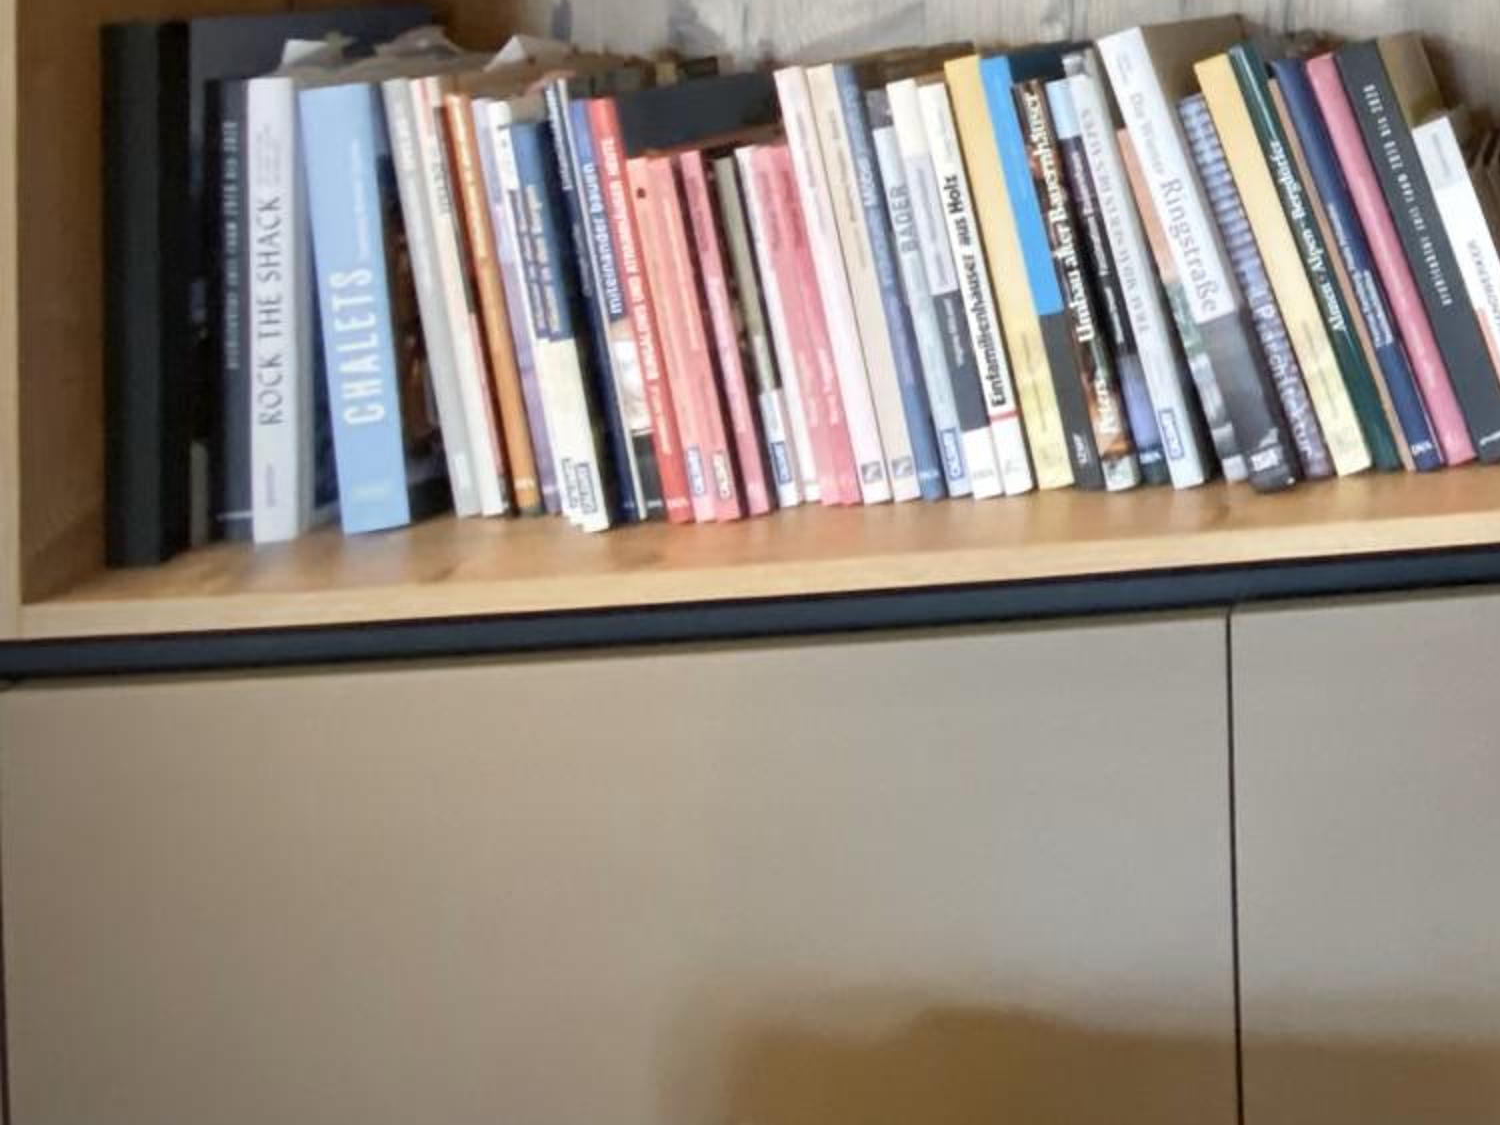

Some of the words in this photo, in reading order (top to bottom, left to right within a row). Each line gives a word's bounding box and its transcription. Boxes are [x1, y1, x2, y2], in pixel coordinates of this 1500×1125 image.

[583, 163, 604, 215] bauen
[942, 174, 964, 215] Holz
[1023, 90, 1067, 223] Bauernhäuser
[1267, 137, 1307, 220] Bergdörfer
[255, 195, 281, 280] SHACK
[592, 215, 624, 316] miteinander
[954, 217, 971, 248] aus
[1052, 221, 1078, 270] alter
[1157, 176, 1217, 314] Ringstraße
[258, 291, 283, 341] THE
[328, 266, 386, 426] CHALETS
[963, 254, 1007, 407] Einfamilienhäuser
[1068, 269, 1095, 343] Umbau
[258, 347, 285, 427] ROCK
[1265, 327, 1318, 460] architektur
